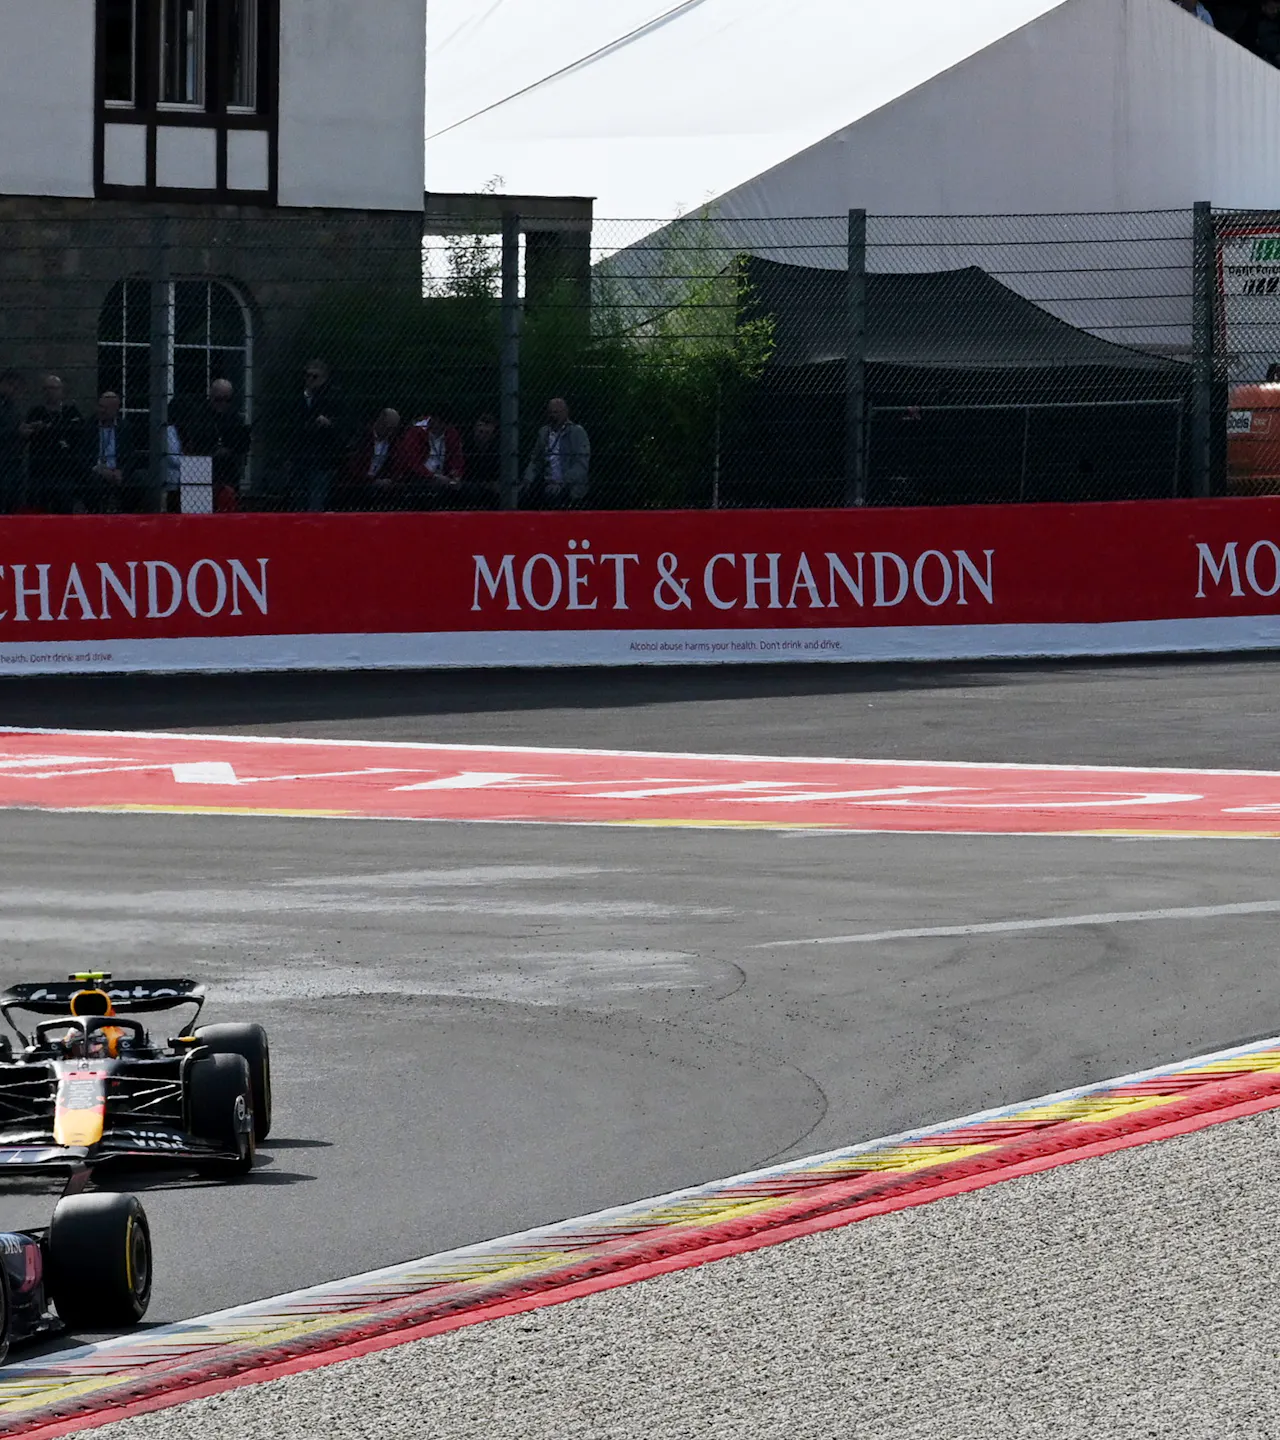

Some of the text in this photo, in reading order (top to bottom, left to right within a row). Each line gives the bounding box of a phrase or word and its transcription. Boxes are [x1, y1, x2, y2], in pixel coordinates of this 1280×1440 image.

[471, 539, 994, 611] MOËT & CHANDON
[1195, 540, 1280, 598] MO
[630, 640, 843, 652] Alcohol abuse harms your health. Don't drink and drive.
[125, 1129, 190, 1151] VISA
